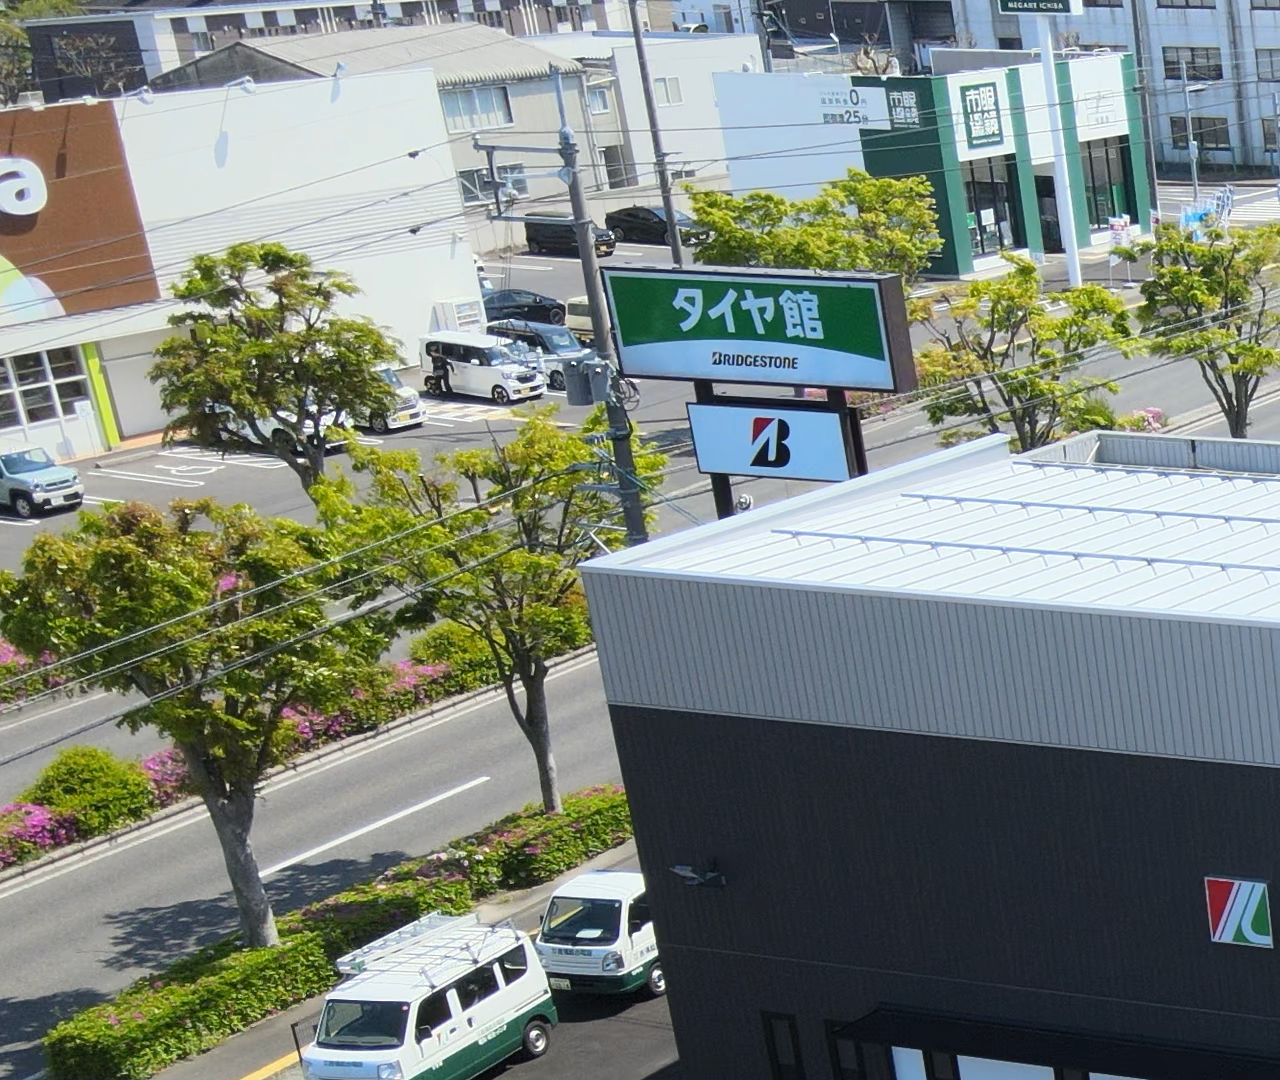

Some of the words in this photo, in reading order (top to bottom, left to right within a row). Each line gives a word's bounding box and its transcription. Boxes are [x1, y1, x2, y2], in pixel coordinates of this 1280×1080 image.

[672, 287, 825, 340] タイヤ館
[711, 351, 799, 370] BRIDGESTONE
